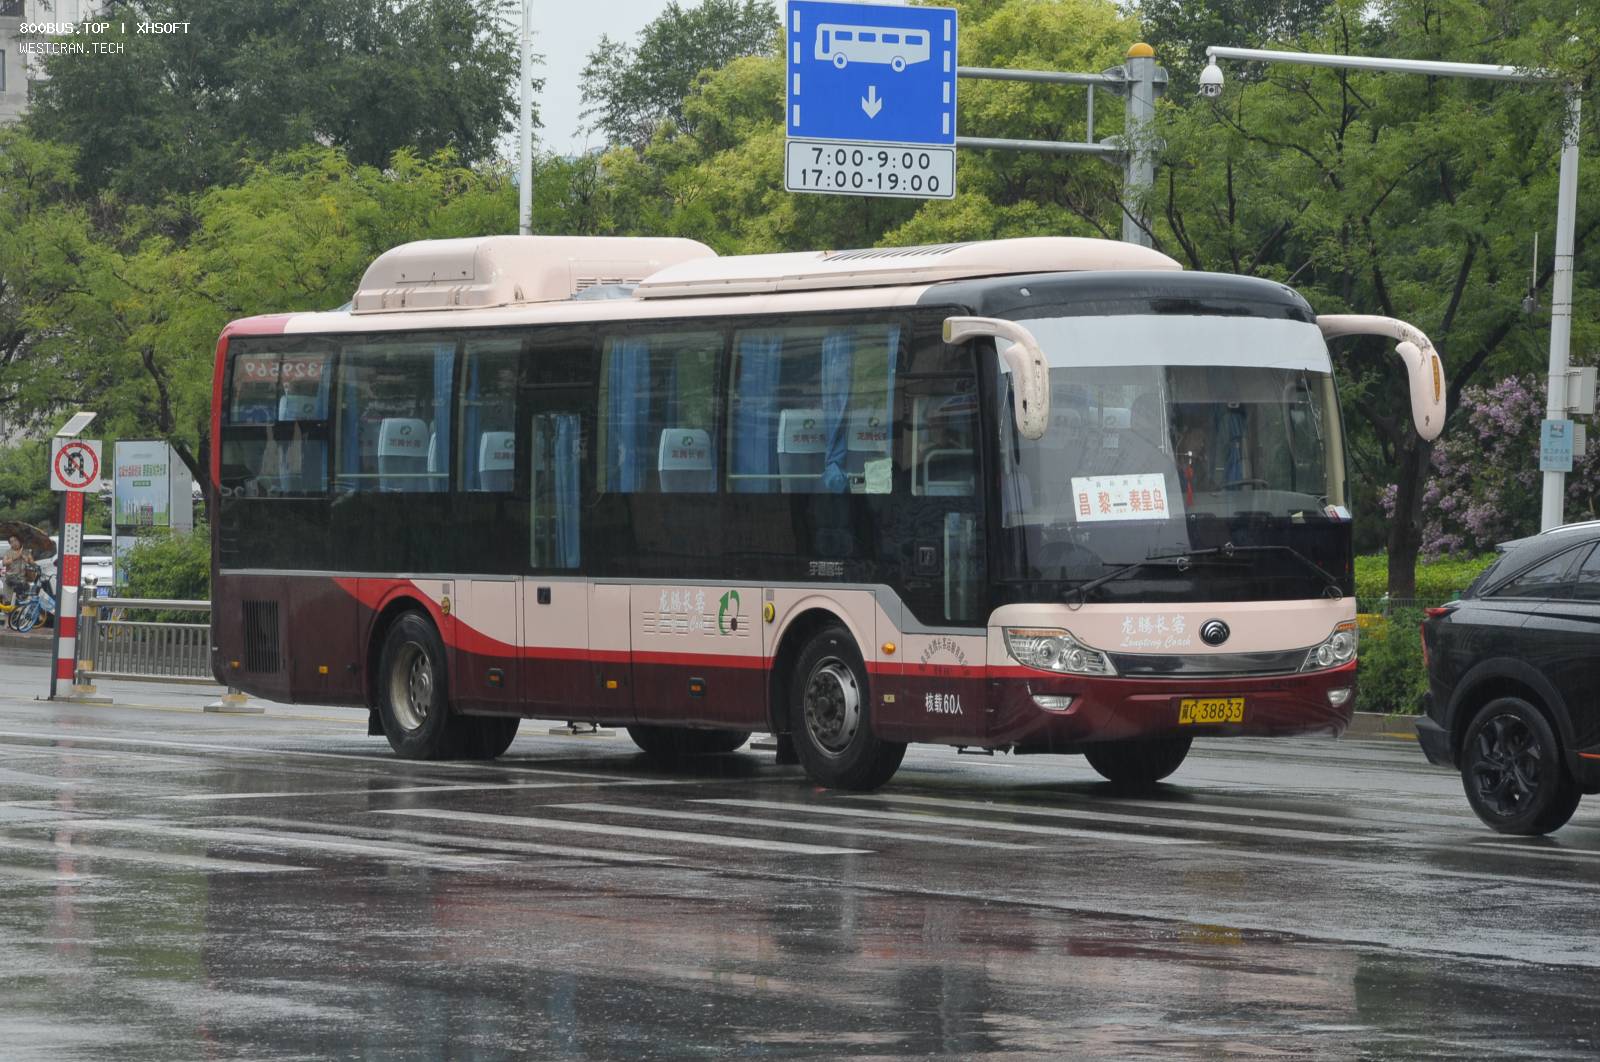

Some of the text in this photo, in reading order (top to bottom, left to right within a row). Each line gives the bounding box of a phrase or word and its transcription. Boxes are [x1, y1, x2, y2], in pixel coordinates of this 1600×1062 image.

[811, 147, 930, 170] 7:00-9:00
[801, 168, 939, 192] 17:00-19:00
[925, 692, 963, 715] 核载60人
